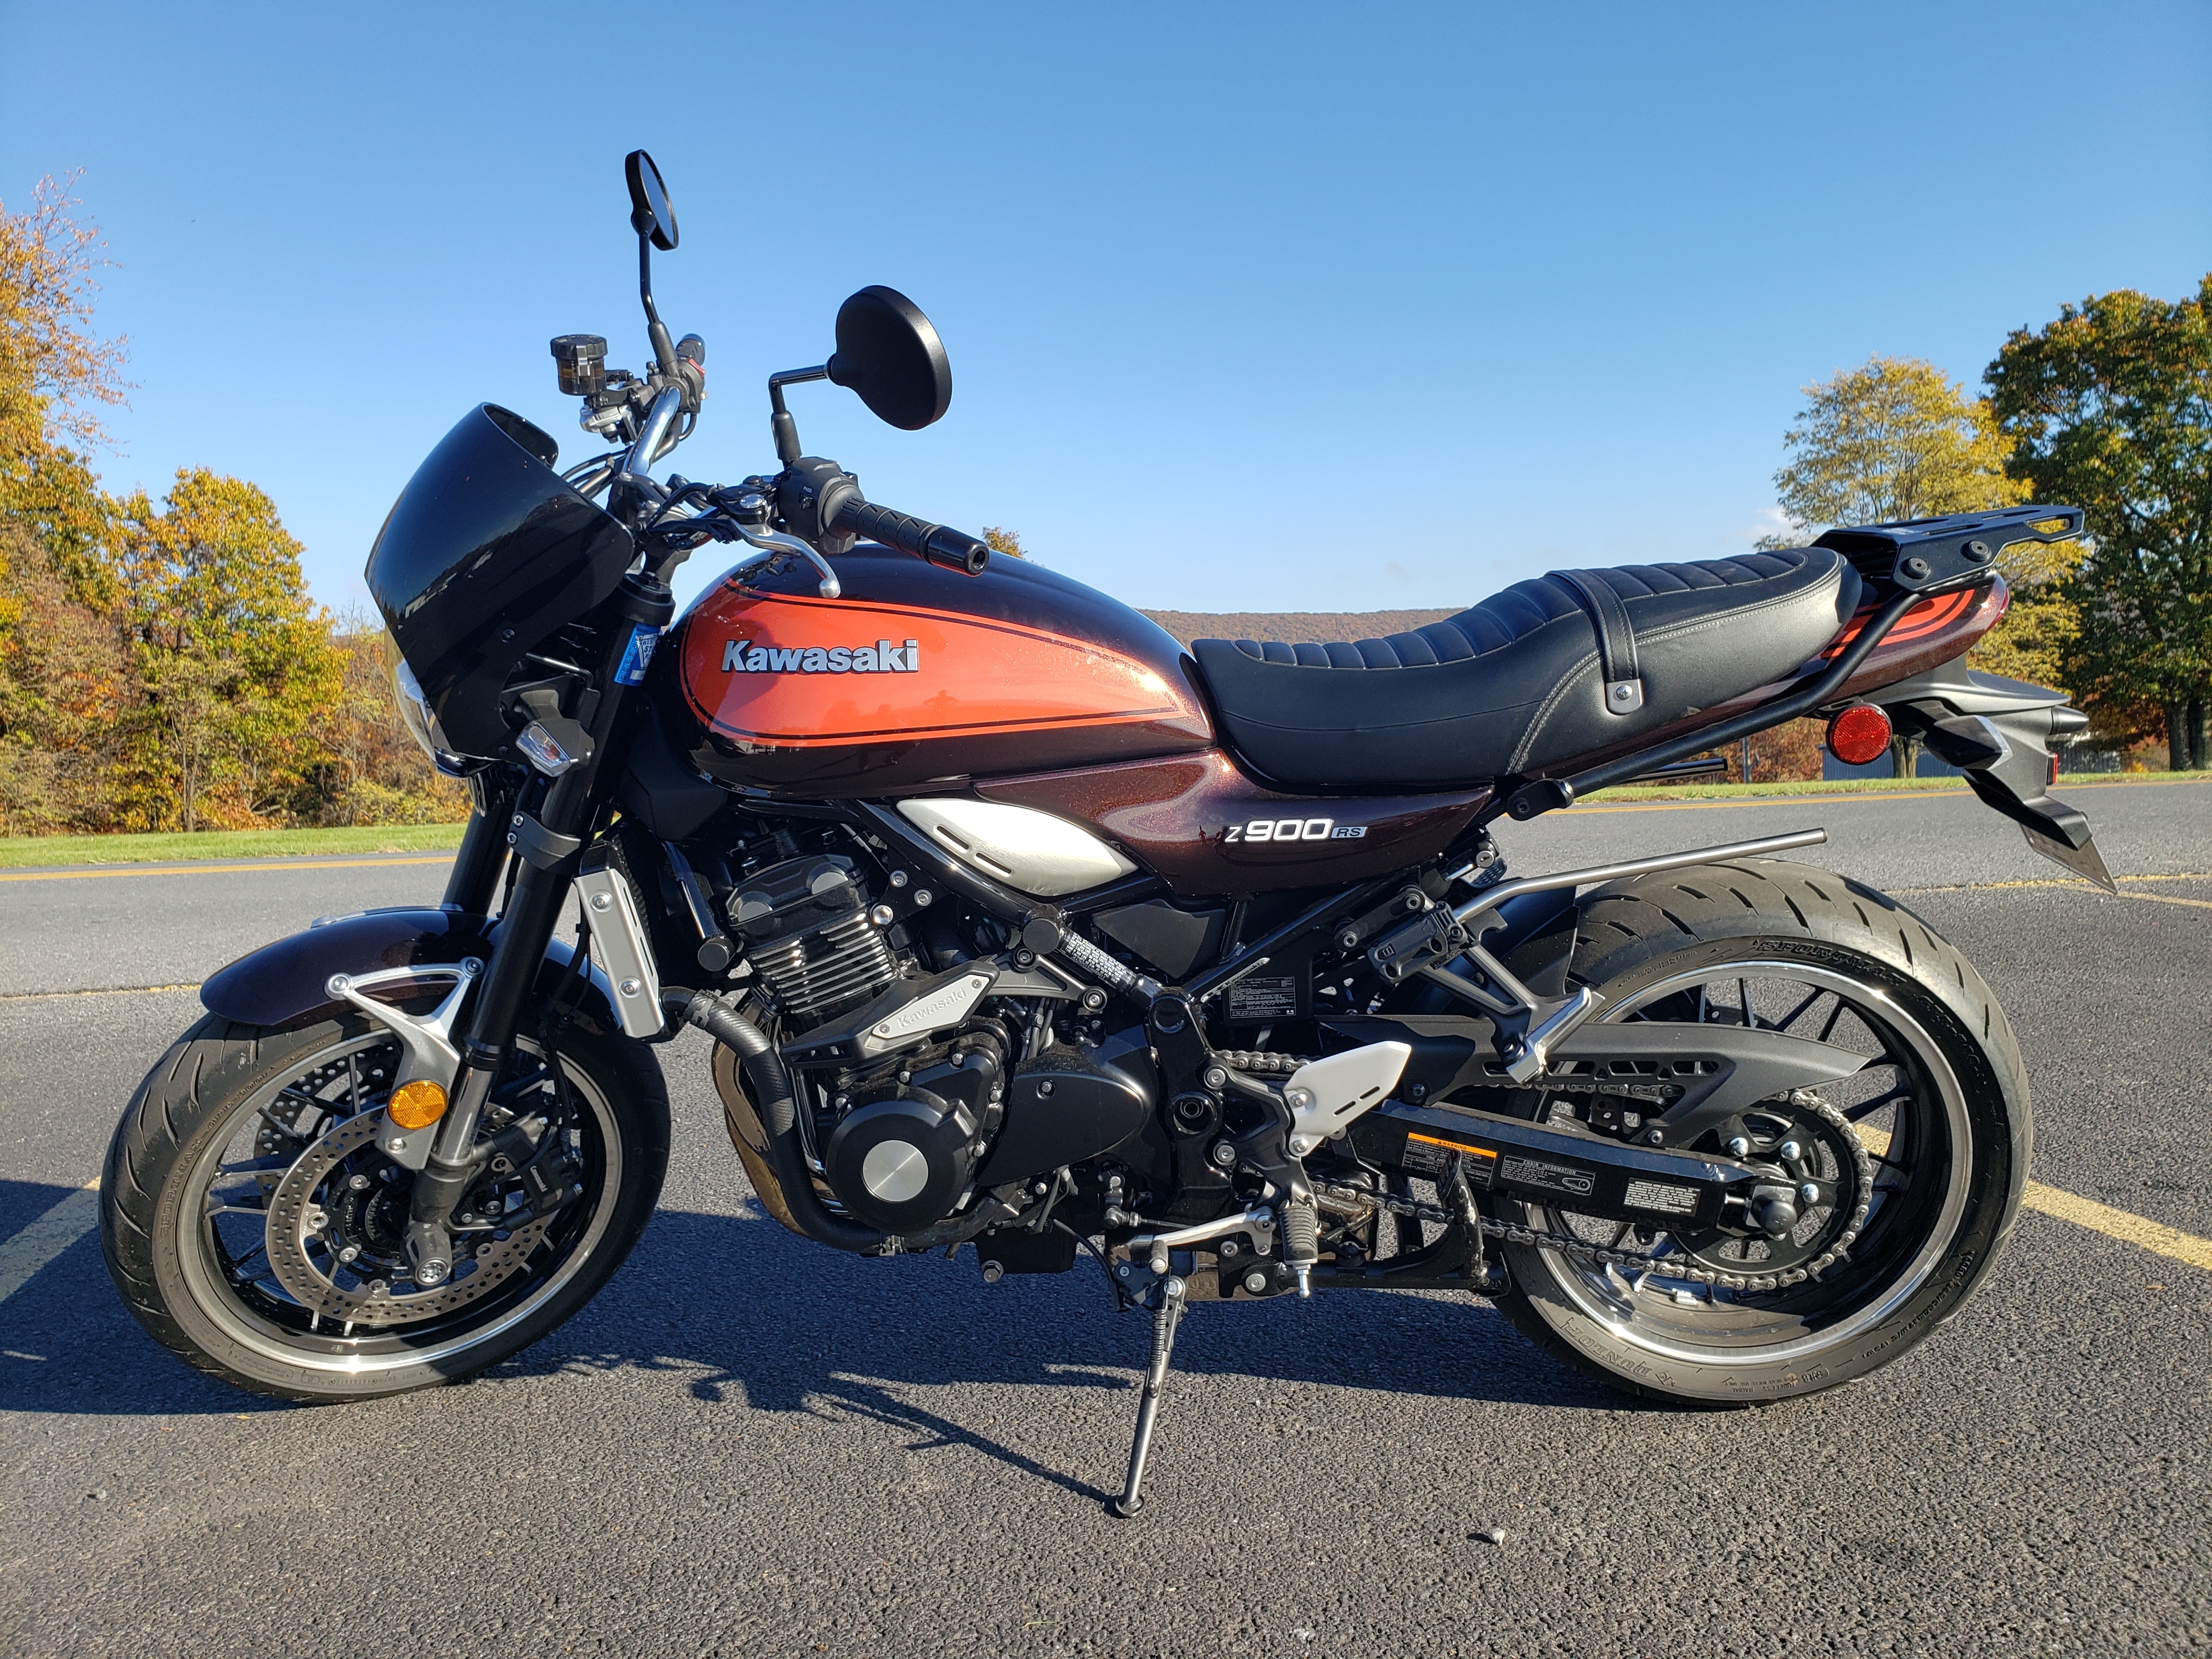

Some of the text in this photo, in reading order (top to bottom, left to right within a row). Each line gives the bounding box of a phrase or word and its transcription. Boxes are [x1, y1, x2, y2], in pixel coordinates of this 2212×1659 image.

[721, 639, 919, 673] Kawasaki
[1336, 828, 1361, 837] RS
[1225, 962, 1260, 986] Kawasaki
[896, 988, 967, 1029] Kawasaki
[1443, 1142, 1466, 1150] WARNING
[1542, 1163, 1576, 1175] INFORMATION
[159, 1136, 202, 1235] SPORTMAX
[1562, 1317, 1654, 1379] DUNLOP
[1762, 1381, 1795, 1391] TUBELESS
